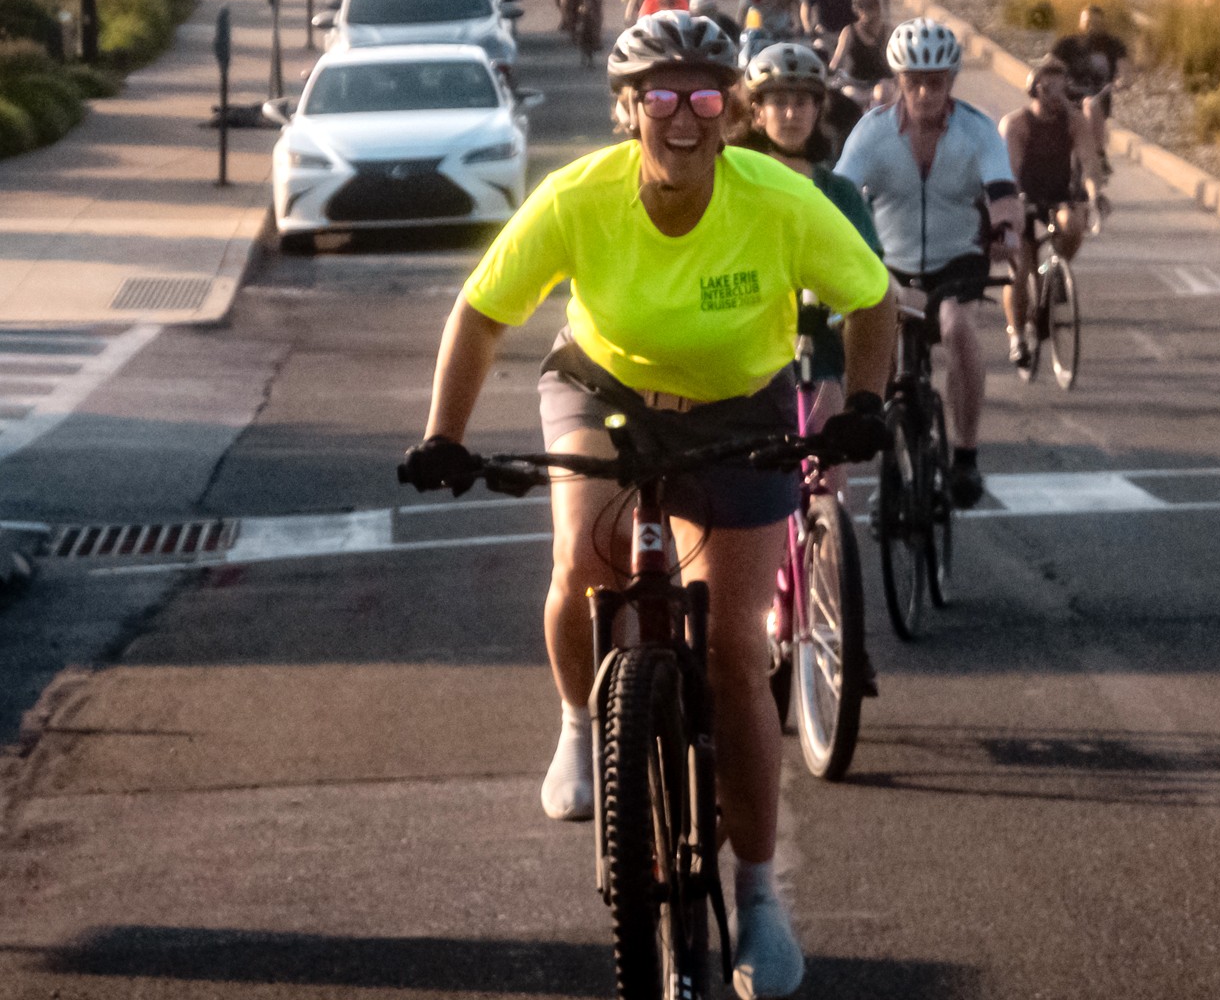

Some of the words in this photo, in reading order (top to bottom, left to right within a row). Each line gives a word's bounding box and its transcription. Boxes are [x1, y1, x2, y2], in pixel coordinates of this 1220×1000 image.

[700, 274, 730, 289] LAKE
[734, 270, 758, 285] ERIE
[701, 283, 759, 300] INTERCLUB
[701, 297, 736, 311] CRUISE
